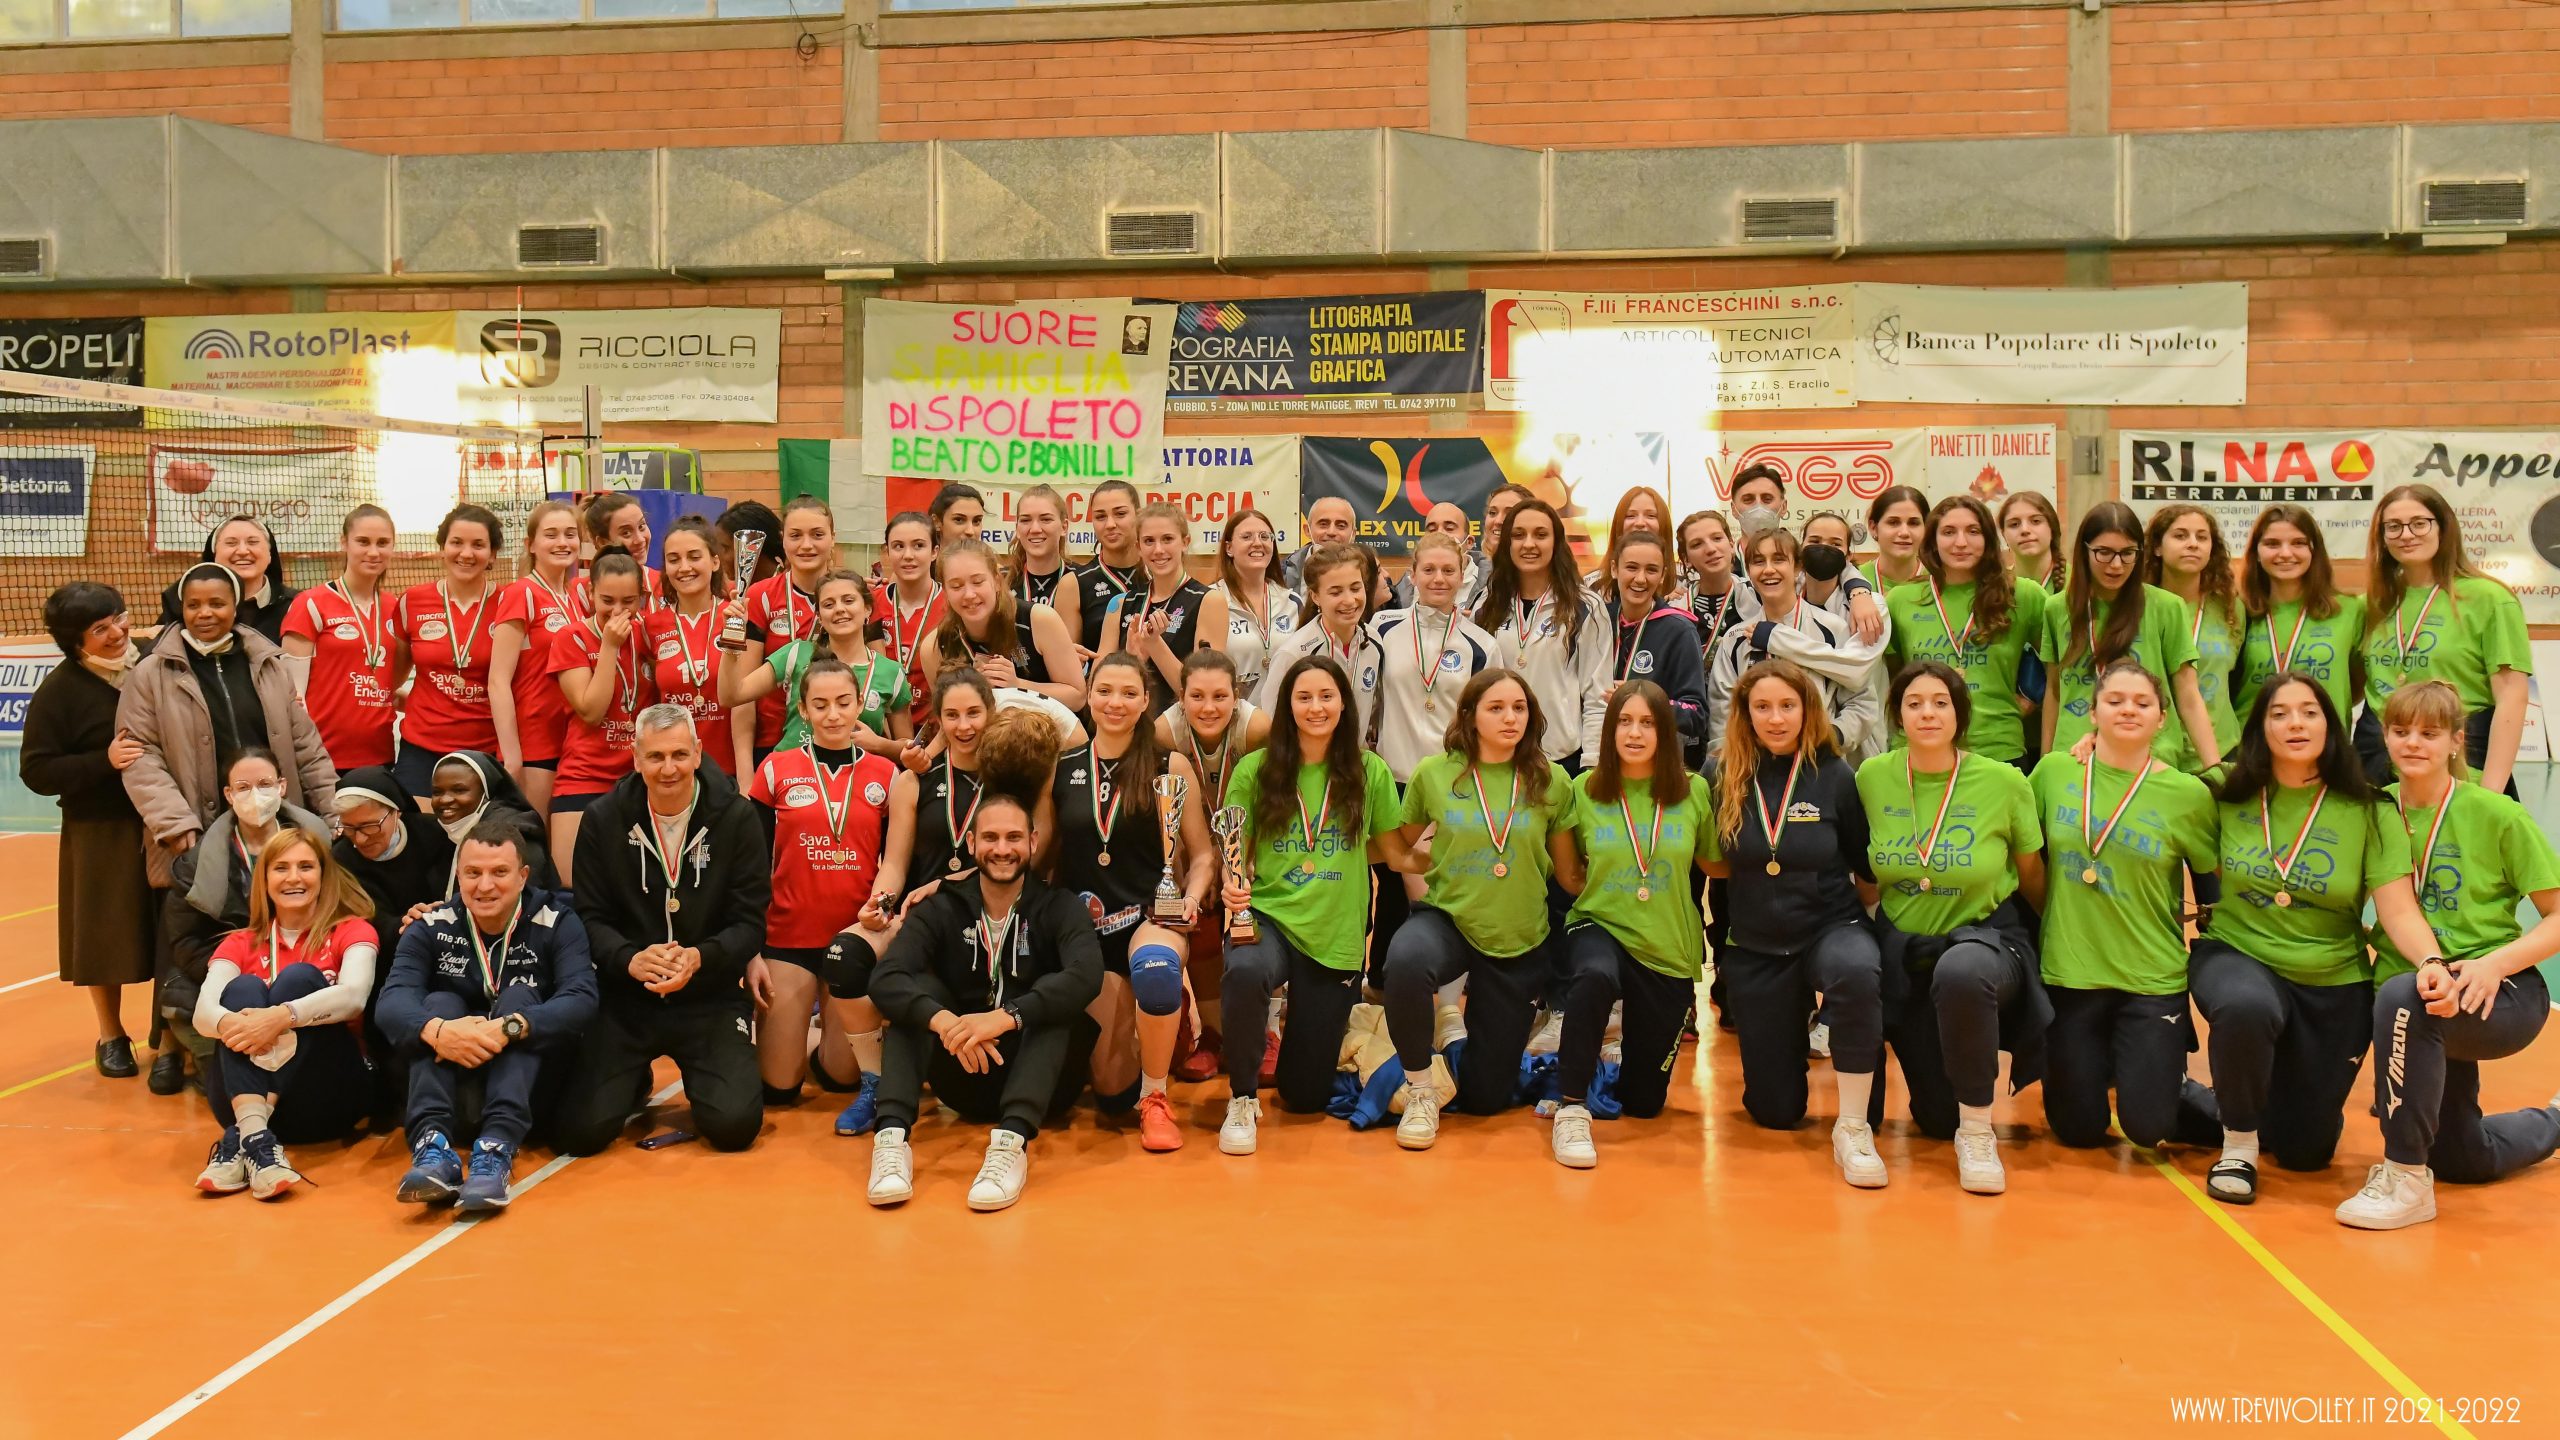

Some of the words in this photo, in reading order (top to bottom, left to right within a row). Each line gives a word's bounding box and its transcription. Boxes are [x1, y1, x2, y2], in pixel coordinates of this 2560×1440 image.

[1583, 298, 1617, 314] F.lli
[1625, 295, 1780, 314] FRANCESCHINI
[1790, 294, 1844, 310] s.n.c.
[1309, 303, 1414, 329] LITOGRAFIA
[952, 309, 1097, 347] SUORE
[1619, 328, 1716, 344] ARTICOLI
[1726, 326, 1812, 343] TECNICI
[248, 327, 411, 358] RotoPlast
[579, 334, 756, 358] RICCIOLA
[1309, 330, 1383, 357] STAMPA
[1387, 328, 1467, 355] DIGITALE
[1905, 330, 1976, 352] Banca
[1985, 331, 2090, 357] Popolare
[2098, 331, 2121, 352] di
[2129, 331, 2217, 357] Spoleto
[1707, 346, 1842, 365] AUTOMATICA
[578, 362, 617, 370] DESIGN
[621, 362, 629, 370] &
[632, 360, 691, 370] CONTRACT
[694, 360, 727, 369] SINCE
[1309, 358, 1386, 385] GRAFICA
[206, 369, 239, 380] NASTRI
[241, 368, 278, 380] ADESIVI
[278, 367, 355, 379] PERSONALIZZATI
[225, 381, 284, 391] MACCHINARI
[286, 381, 292, 390] E
[294, 379, 341, 390] SOLUZIONI
[341, 378, 361, 388] PER
[1773, 381, 1785, 390] S.
[1788, 379, 1831, 390] Eraclio
[699, 394, 721, 402] 0742
[1211, 401, 1217, 411] 5
[1226, 400, 1249, 412] ZONA
[1251, 400, 1280, 412] IND.LE
[1281, 400, 1309, 411] TORRE
[1354, 399, 1378, 410] TREVI
[1383, 399, 1398, 410] TEL
[1399, 398, 1422, 410] 0742
[1423, 397, 1457, 409] 391710
[1717, 393, 1738, 403] Fax
[1741, 392, 1782, 403] 670941
[924, 394, 1143, 441] SPOLETO
[1929, 433, 1986, 457] PANETTI
[1992, 432, 2052, 457] DANIELE
[891, 436, 1001, 475] BEATO
[2131, 440, 2319, 483] RI.NA
[2144, 486, 2363, 500] FERRAMENTA
[2326, 520, 2349, 528] Trevi
[2491, 521, 2504, 529] 41
[1231, 620, 1249, 635] 37
[677, 659, 710, 685] 15
[664, 691, 693, 704] Sava
[788, 793, 816, 803] MONINI
[1099, 781, 1111, 803] 8
[798, 832, 831, 847] Sava
[812, 863, 821, 871] for
[1931, 885, 1963, 898] siam
[1102, 911, 1141, 935] Sicilia
[439, 951, 470, 965] Lucky
[438, 961, 467, 975] Wind
